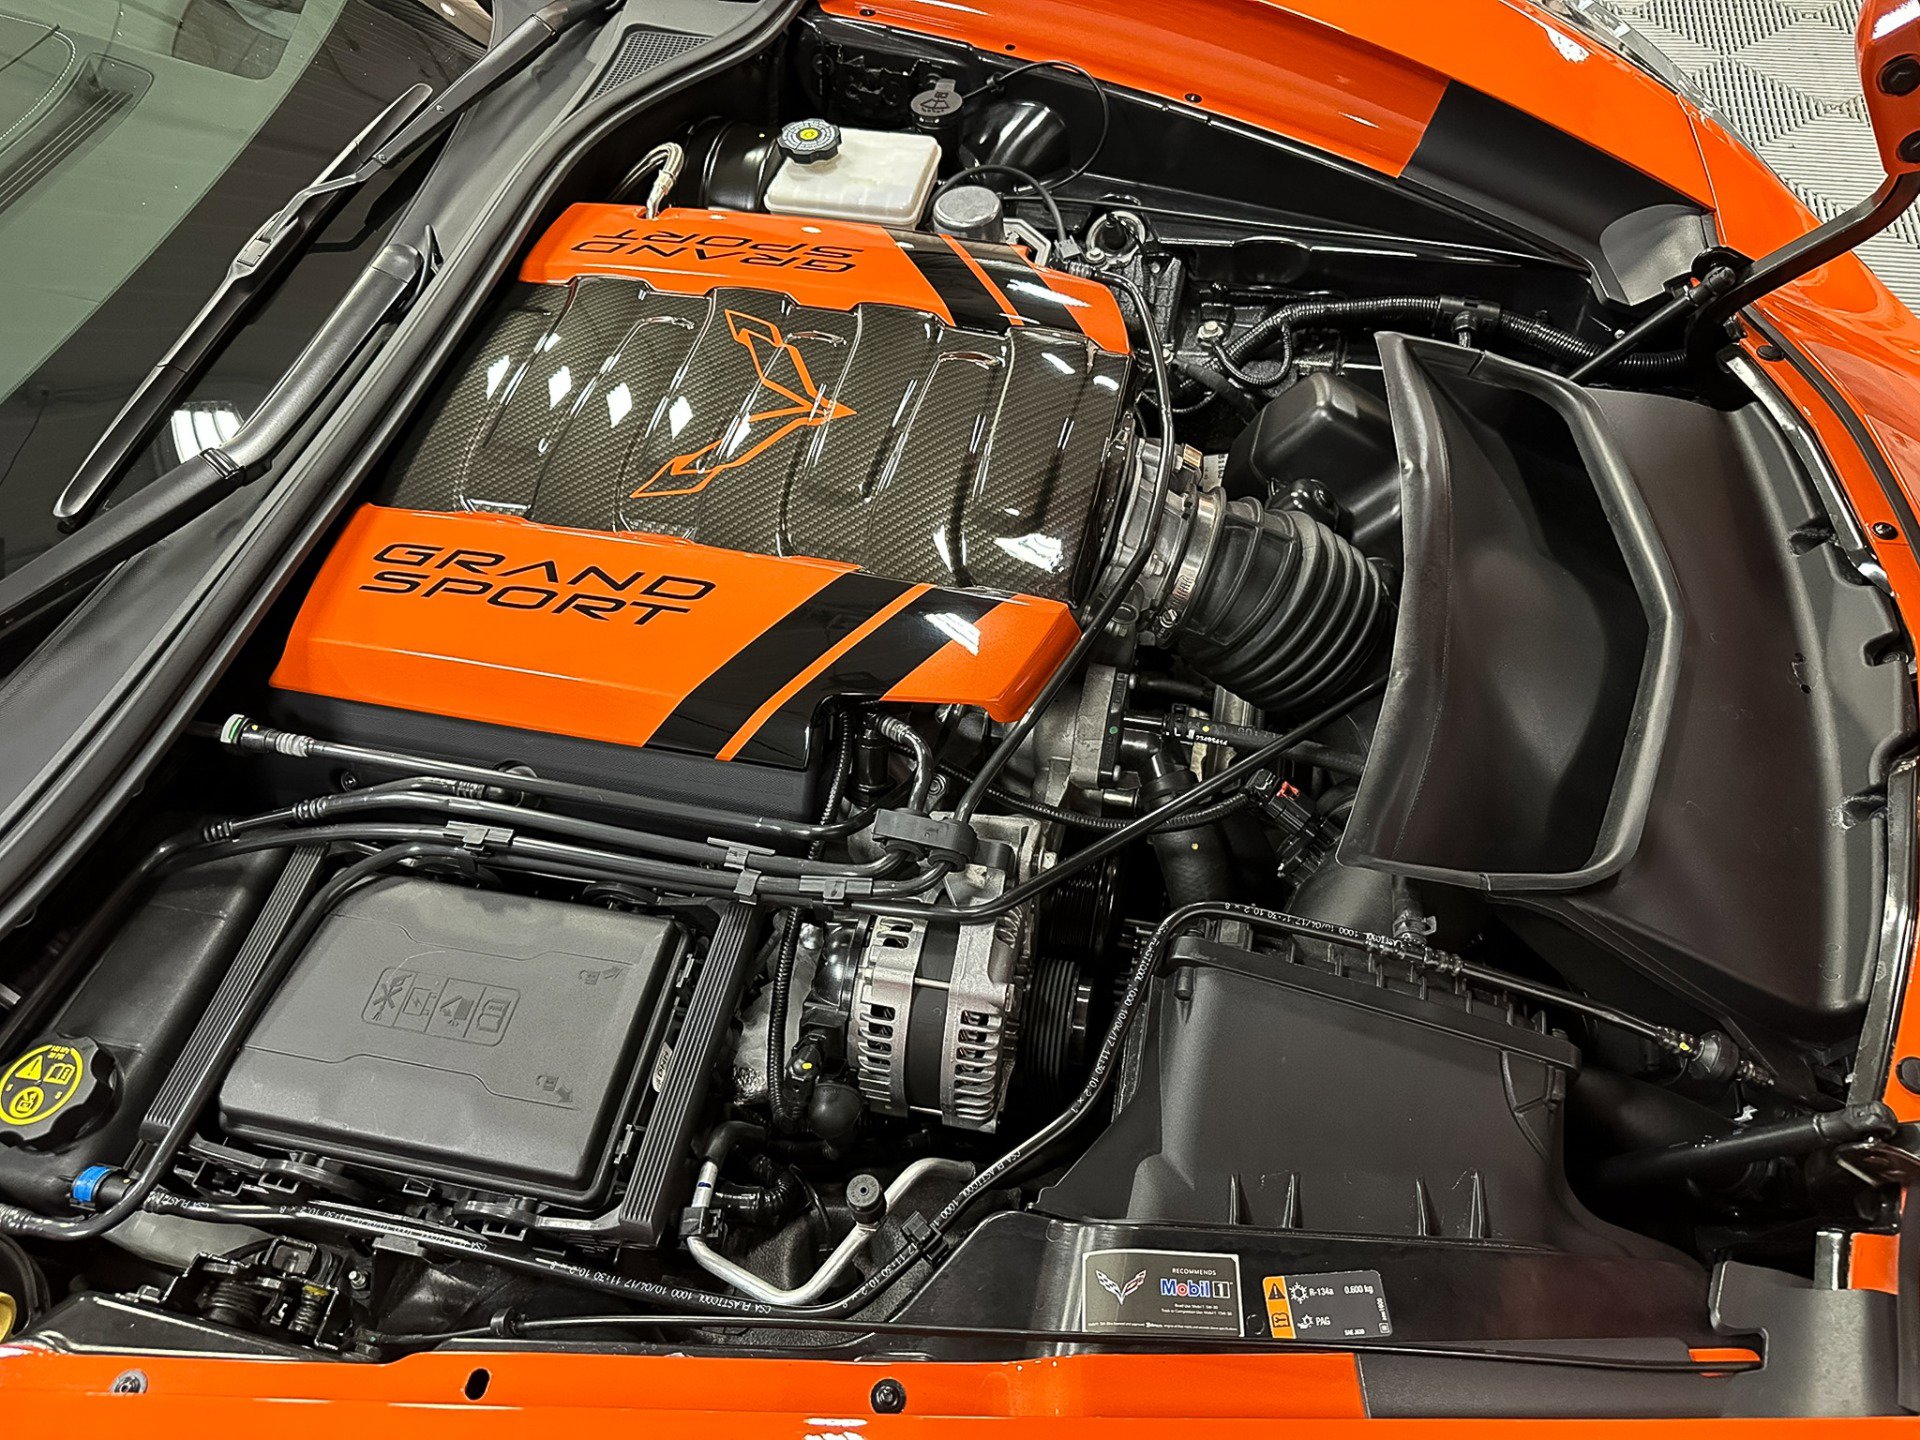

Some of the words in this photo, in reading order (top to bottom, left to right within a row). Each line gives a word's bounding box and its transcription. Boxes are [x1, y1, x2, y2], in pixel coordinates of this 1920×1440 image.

[594, 229, 864, 258] SPORT
[571, 241, 856, 272] GRAND
[373, 544, 716, 600] GRAND
[359, 571, 691, 625] SPORT
[940, 1200, 959, 1219] 1000
[881, 1254, 905, 1277] 11:30
[1172, 1267, 1217, 1276] RECOMMENDS
[593, 1271, 621, 1286] 11:30
[624, 1279, 667, 1297] 10/04/17
[1160, 1278, 1211, 1298] Mobil
[671, 1288, 693, 1300] 1000
[1308, 1287, 1335, 1297] R-134a
[1364, 1284, 1374, 1295] kg
[698, 1293, 751, 1312] PLASTICOOL
[754, 1303, 772, 1315] CSA
[1315, 1316, 1331, 1326] PAG
